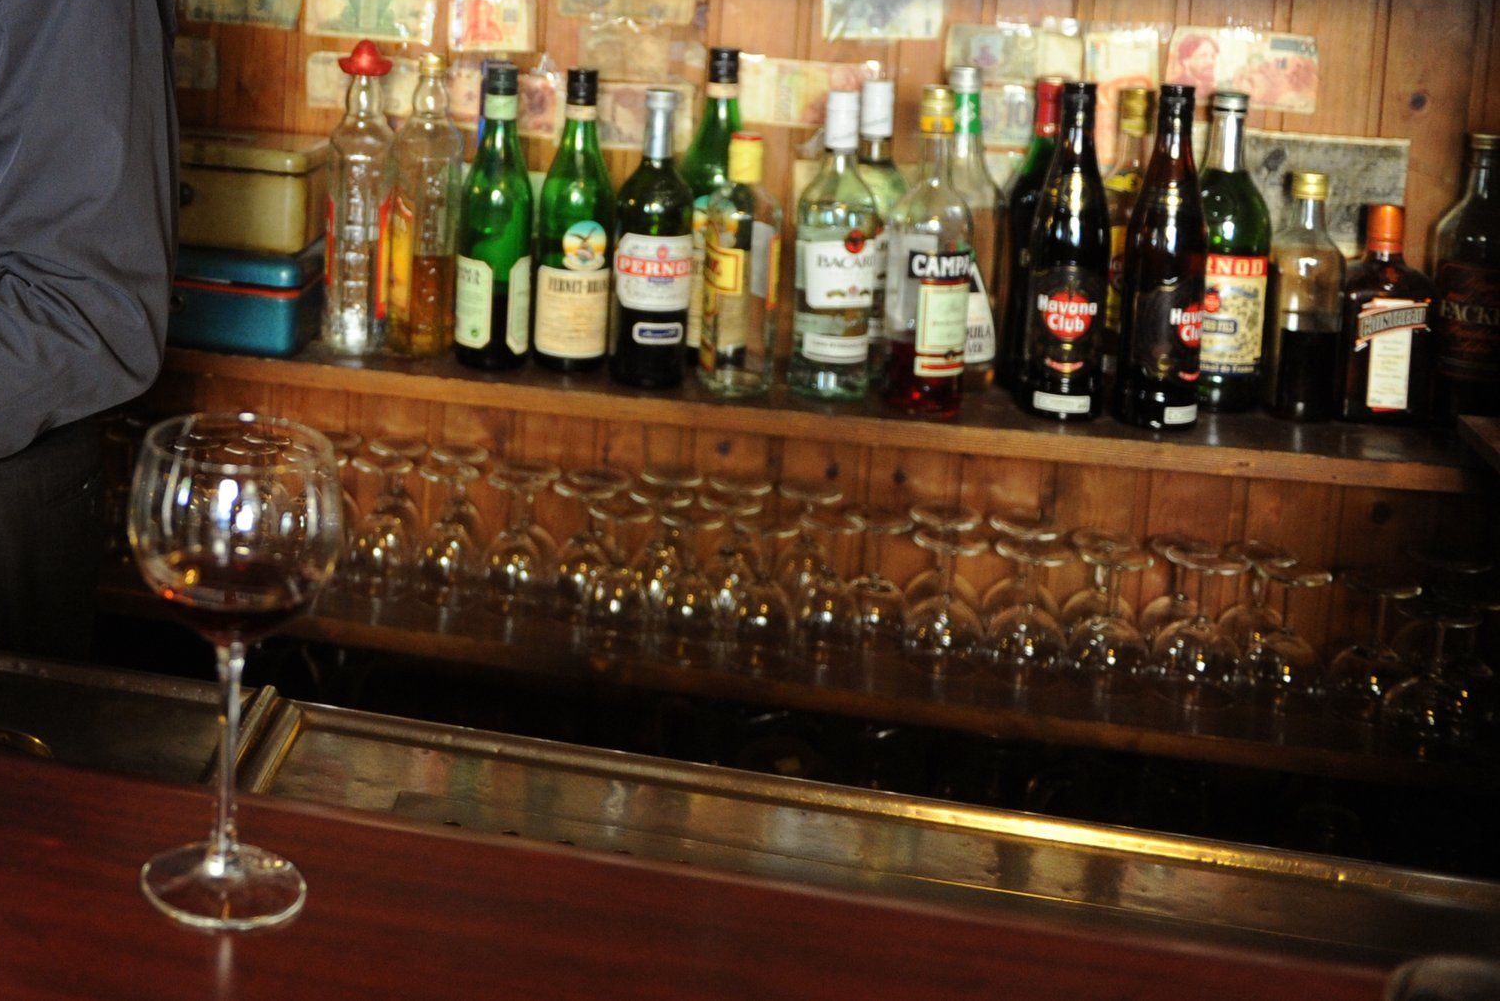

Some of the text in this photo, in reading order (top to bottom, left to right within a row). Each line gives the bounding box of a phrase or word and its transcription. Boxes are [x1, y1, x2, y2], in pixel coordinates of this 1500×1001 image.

[618, 255, 692, 277] PERNO
[818, 253, 873, 269] BACAR
[911, 253, 971, 278] CAMPA
[1037, 293, 1098, 316] Havana
[1047, 313, 1086, 333] Club
